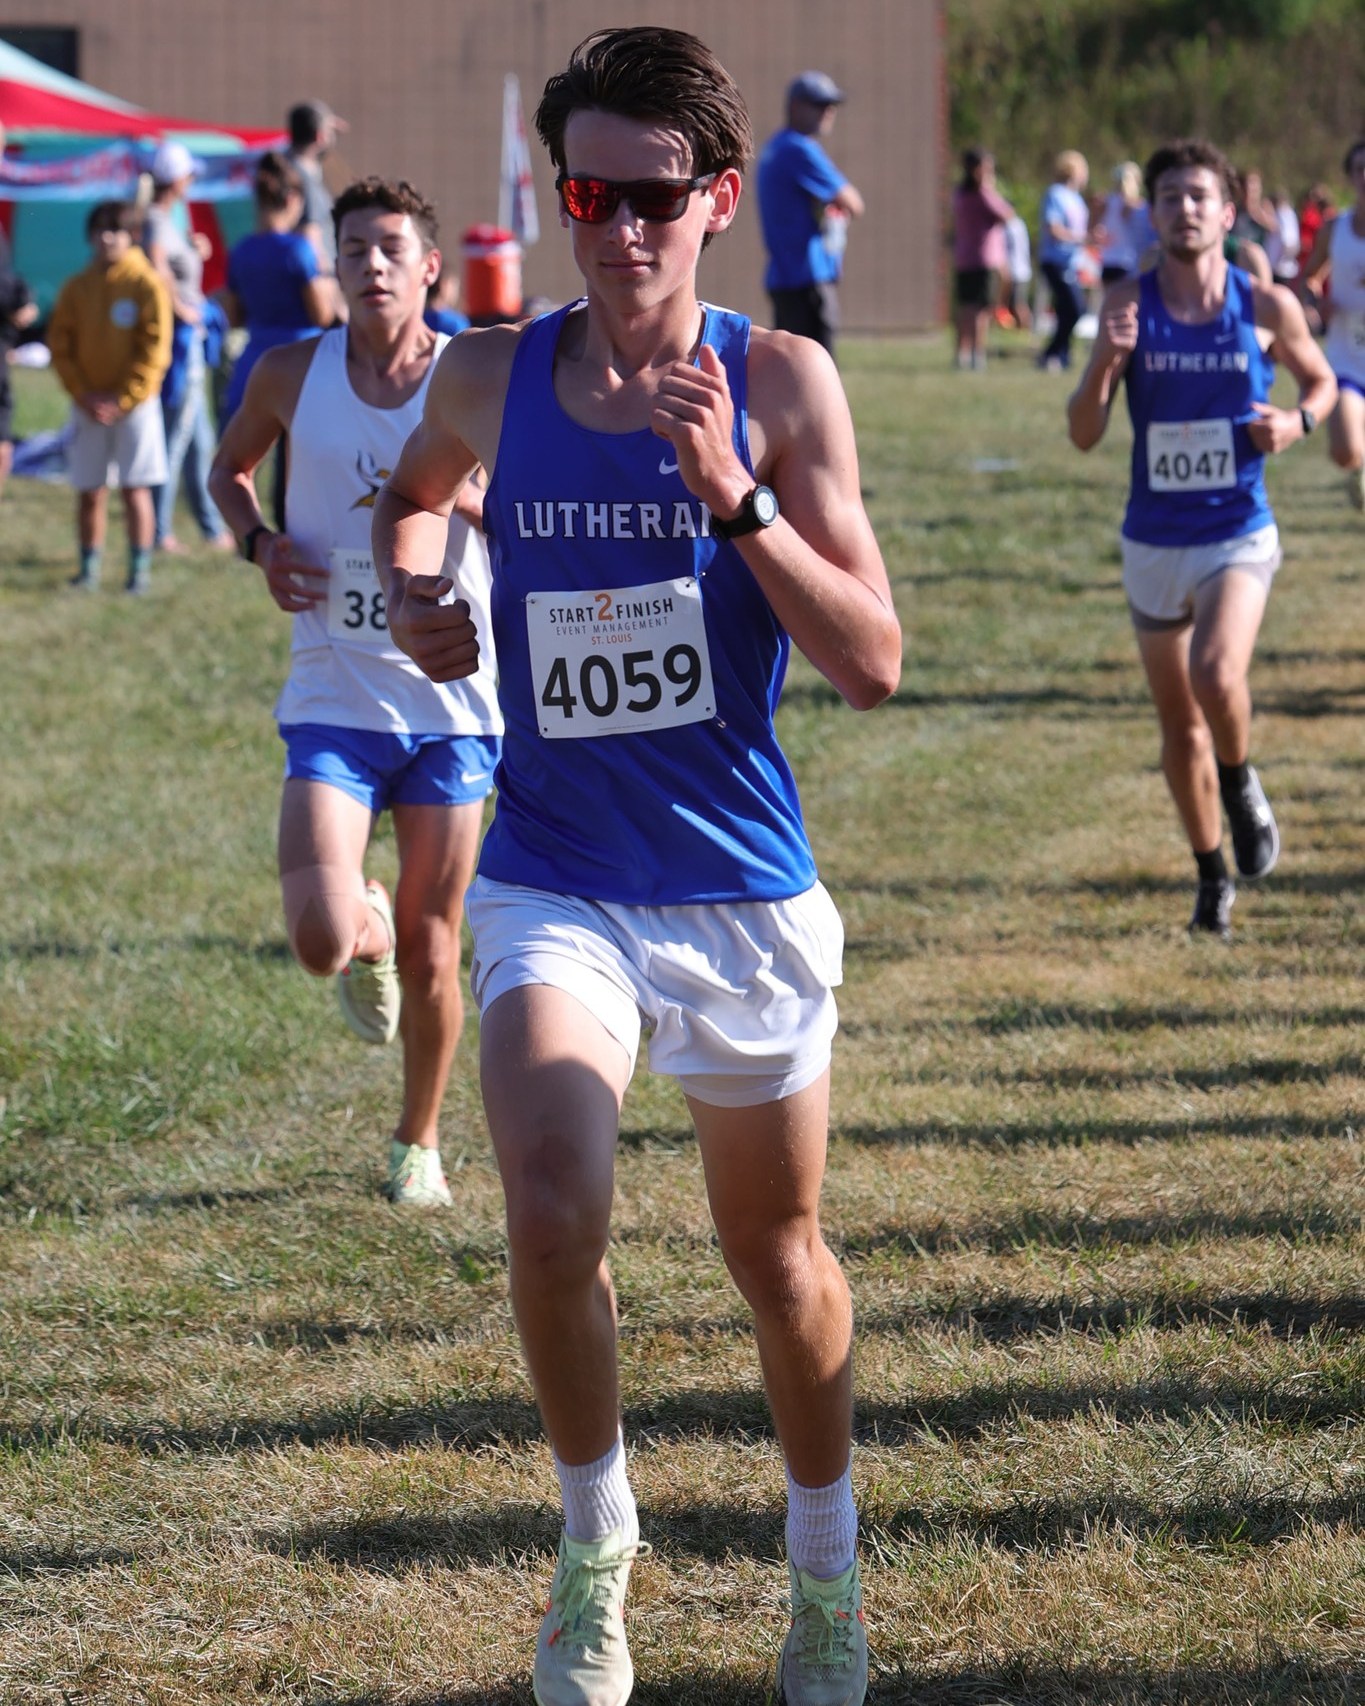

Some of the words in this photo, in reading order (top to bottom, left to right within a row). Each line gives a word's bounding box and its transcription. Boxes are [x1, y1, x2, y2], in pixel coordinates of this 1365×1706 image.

[1144, 352, 1249, 373] LUTHERAN
[1154, 450, 1229, 482] 4047
[344, 558, 374, 570] STAR
[549, 606, 594, 624] START
[594, 593, 614, 621] 2
[617, 597, 674, 620] FINISH
[556, 624, 587, 636] EVENT
[593, 616, 668, 634] MANAGEMENT
[591, 635, 604, 645] ST.
[607, 633, 632, 645] LOUIS
[541, 643, 702, 719] 4059
